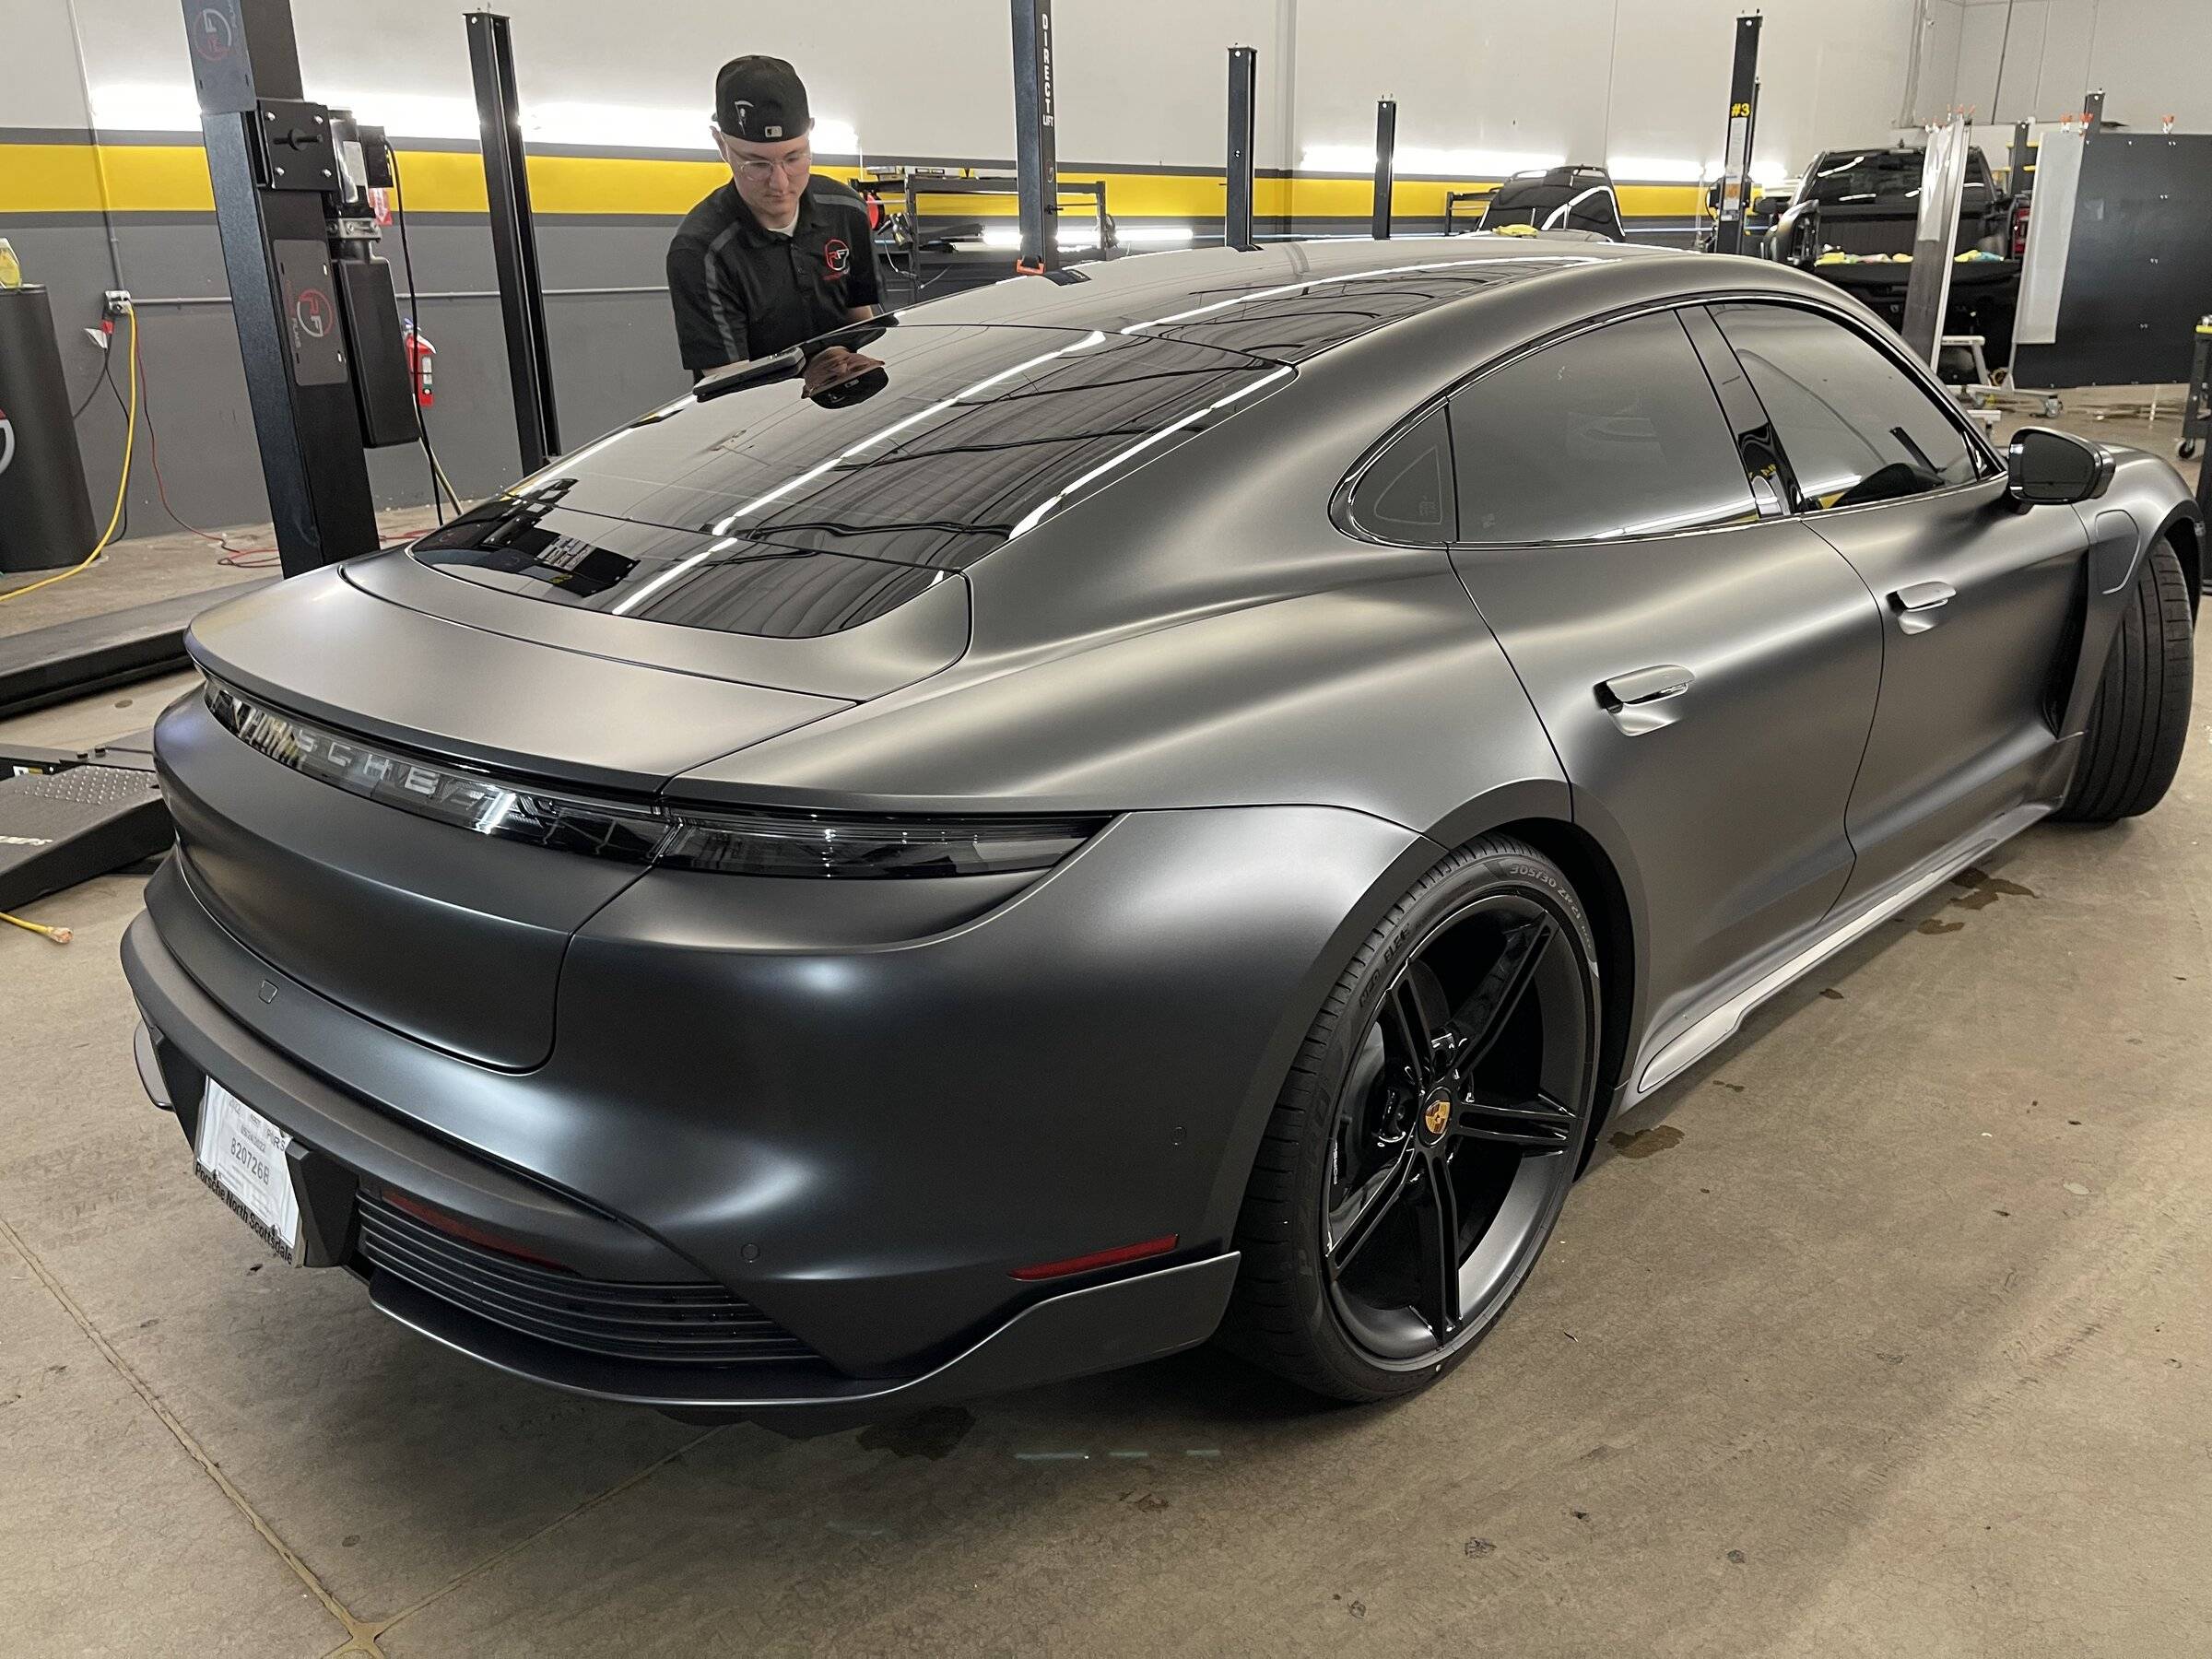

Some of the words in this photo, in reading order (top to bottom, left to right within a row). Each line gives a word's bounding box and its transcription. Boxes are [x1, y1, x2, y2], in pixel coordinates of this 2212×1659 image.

[1042, 13, 1052, 113] DIRECT
[1042, 112, 1054, 127] LIFT
[1731, 102, 1751, 118] #3
[195, 1163, 226, 1201] Porsche
[227, 1189, 249, 1224] North
[249, 1212, 293, 1265] Scottsdale
